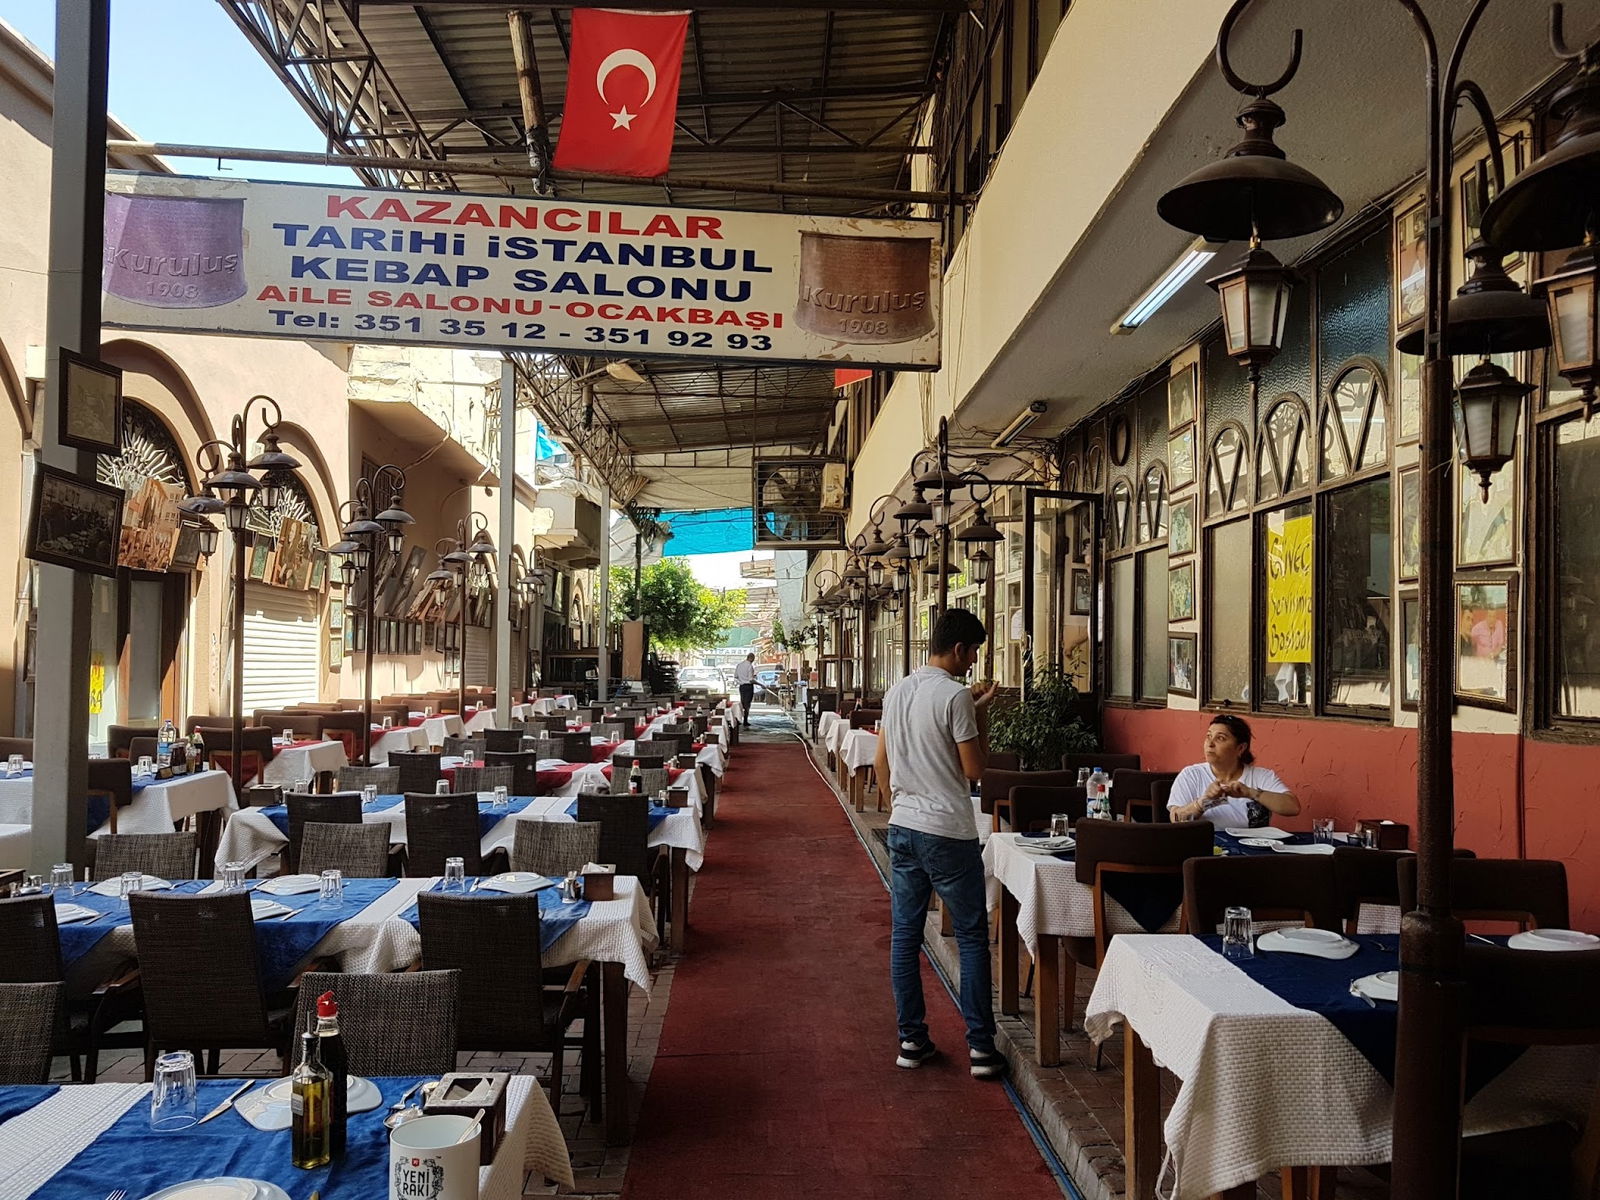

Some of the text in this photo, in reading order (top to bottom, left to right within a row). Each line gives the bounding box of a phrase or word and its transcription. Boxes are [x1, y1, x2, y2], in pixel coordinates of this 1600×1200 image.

[327, 195, 723, 239] KAZANCILAR
[107, 247, 239, 277] Kuruluş
[146, 280, 200, 299] 1908
[291, 256, 751, 303] KEBAP SALONU
[803, 285, 926, 314] Kuruluş
[268, 309, 339, 328] Tel:
[354, 314, 422, 333] 351
[439, 318, 486, 336] 35
[501, 322, 546, 339] 12
[584, 326, 649, 345] 351
[667, 330, 713, 348] 92
[726, 333, 773, 351] 93
[838, 318, 889, 336] 1908
[402, 1182, 429, 1197] RAKI
